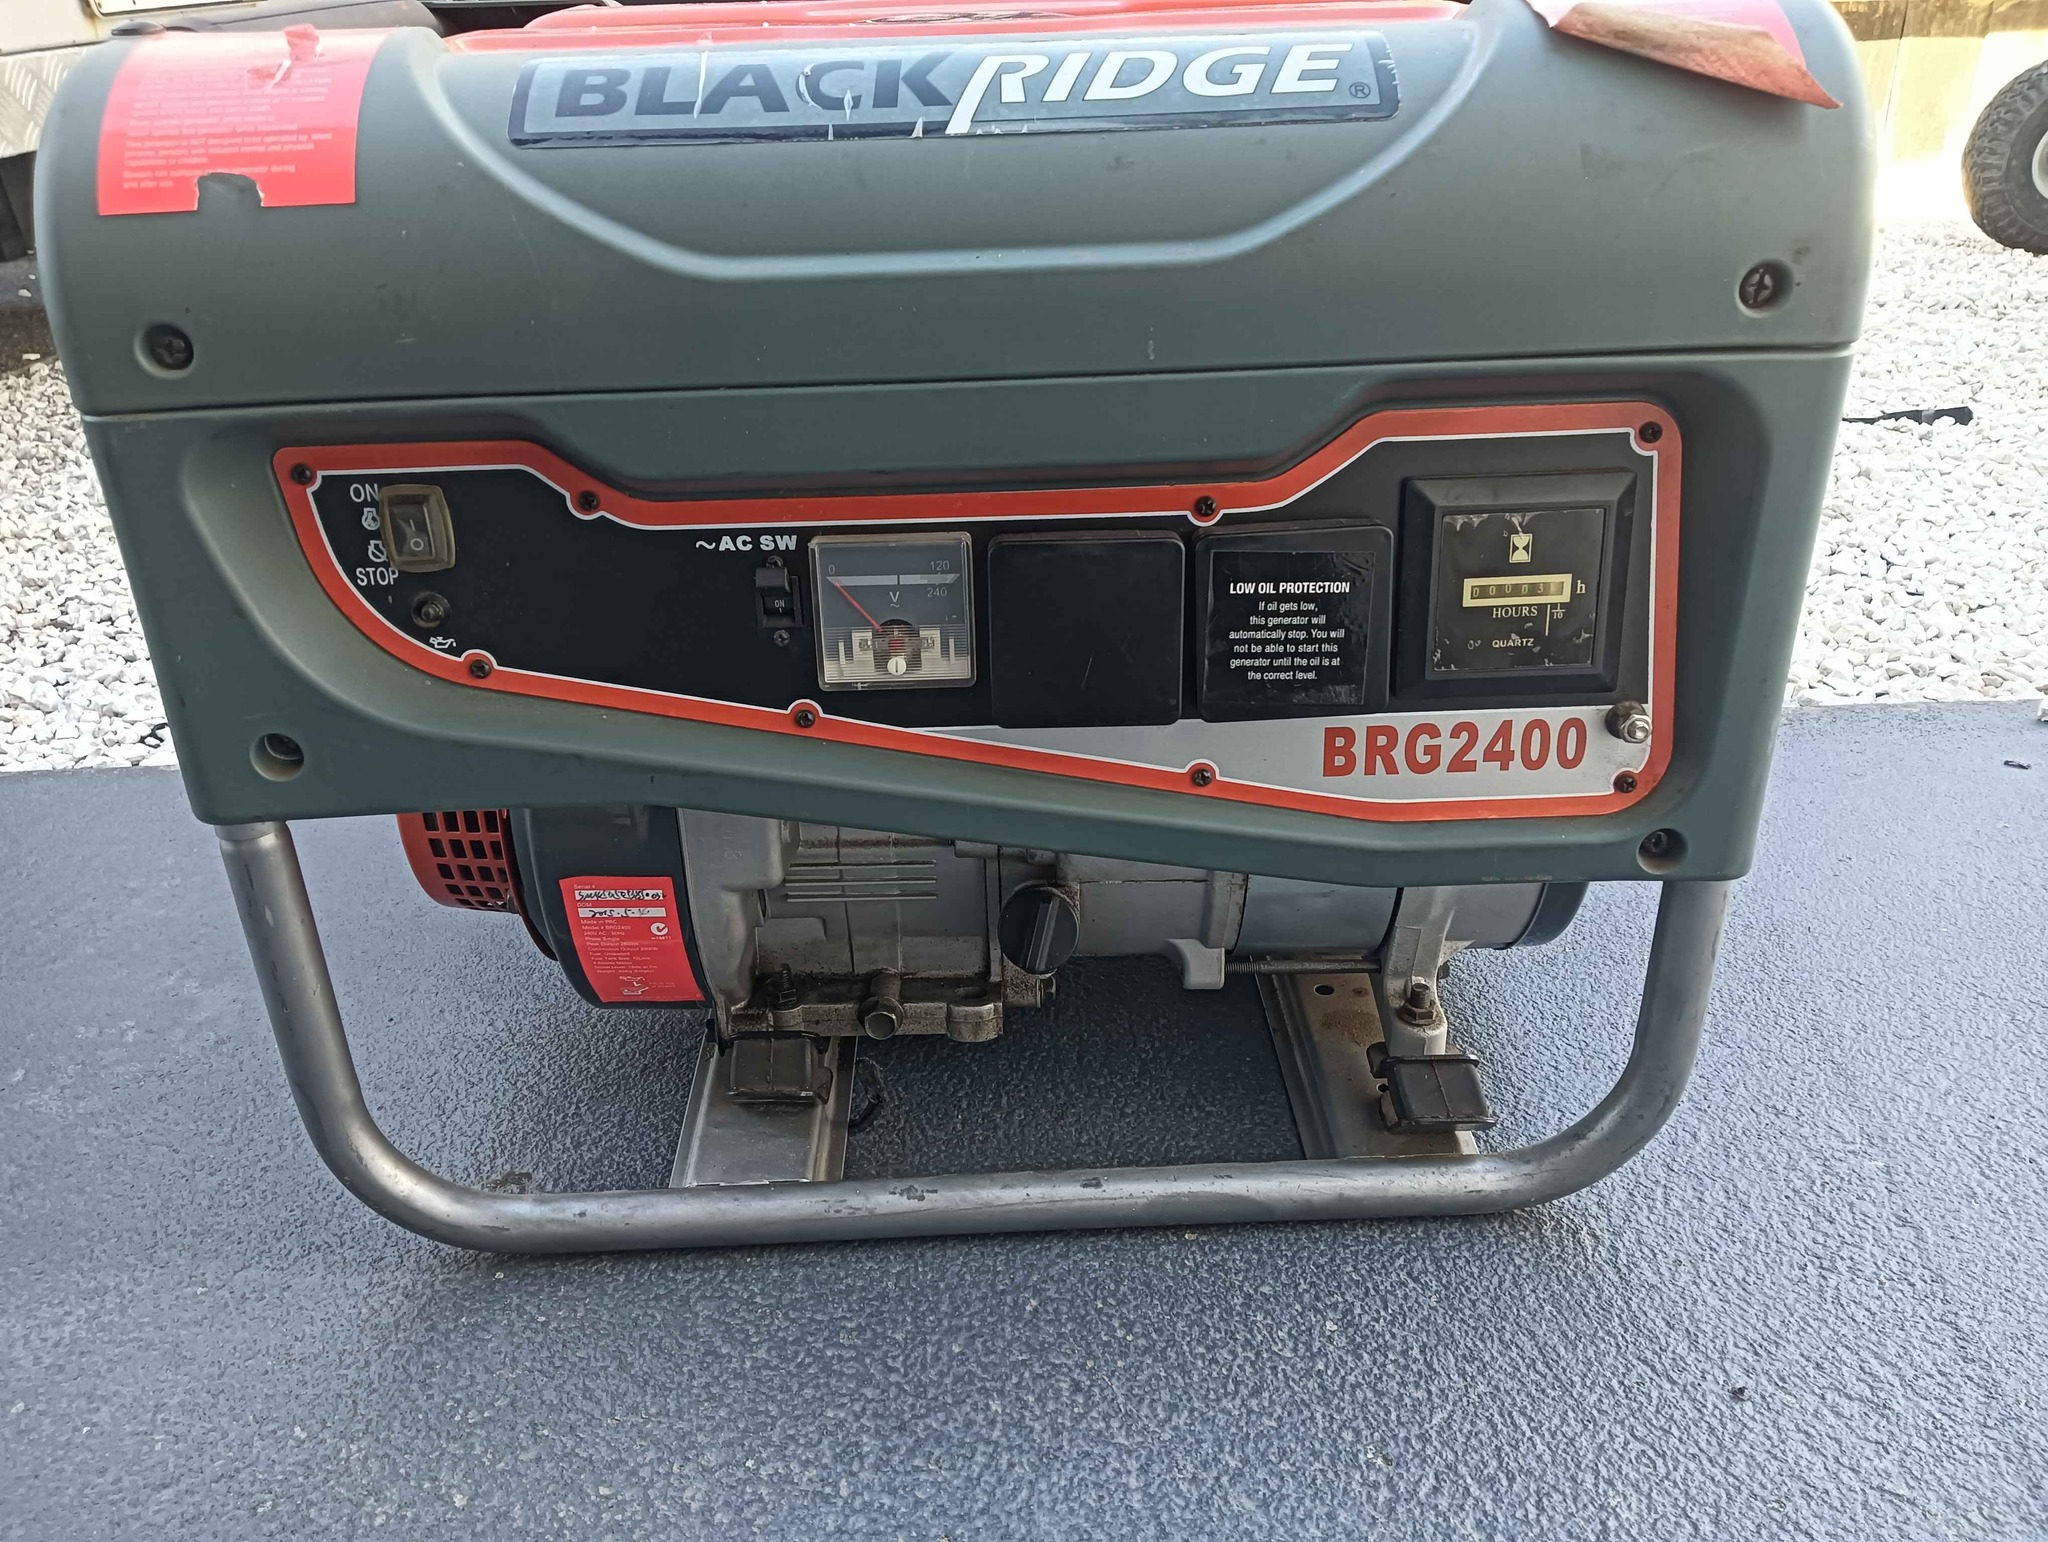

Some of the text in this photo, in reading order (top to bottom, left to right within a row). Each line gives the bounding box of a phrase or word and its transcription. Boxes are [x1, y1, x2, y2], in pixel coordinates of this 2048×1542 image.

[554, 43, 1354, 134] BLACKRIDGE
[350, 484, 379, 502] ON
[759, 535, 797, 551] SW
[930, 560, 950, 571] 120
[355, 567, 399, 586] STOP
[927, 587, 948, 598] 240
[1229, 581, 1350, 594] LOW OIL PROTECTION
[774, 599, 785, 608] ON
[1258, 601, 1318, 613] If oil gets low,
[1492, 606, 1538, 619] HOURS
[1250, 615, 1326, 627] this generator will
[1229, 629, 1345, 641] automatically stop. You will
[1233, 643, 1339, 653] not be able to start this
[1492, 638, 1534, 648] QUARTZ
[1229, 657, 1341, 669] generator until the oil is at
[1247, 671, 1317, 680] the correct level.
[1323, 717, 1588, 778] BRG2400
